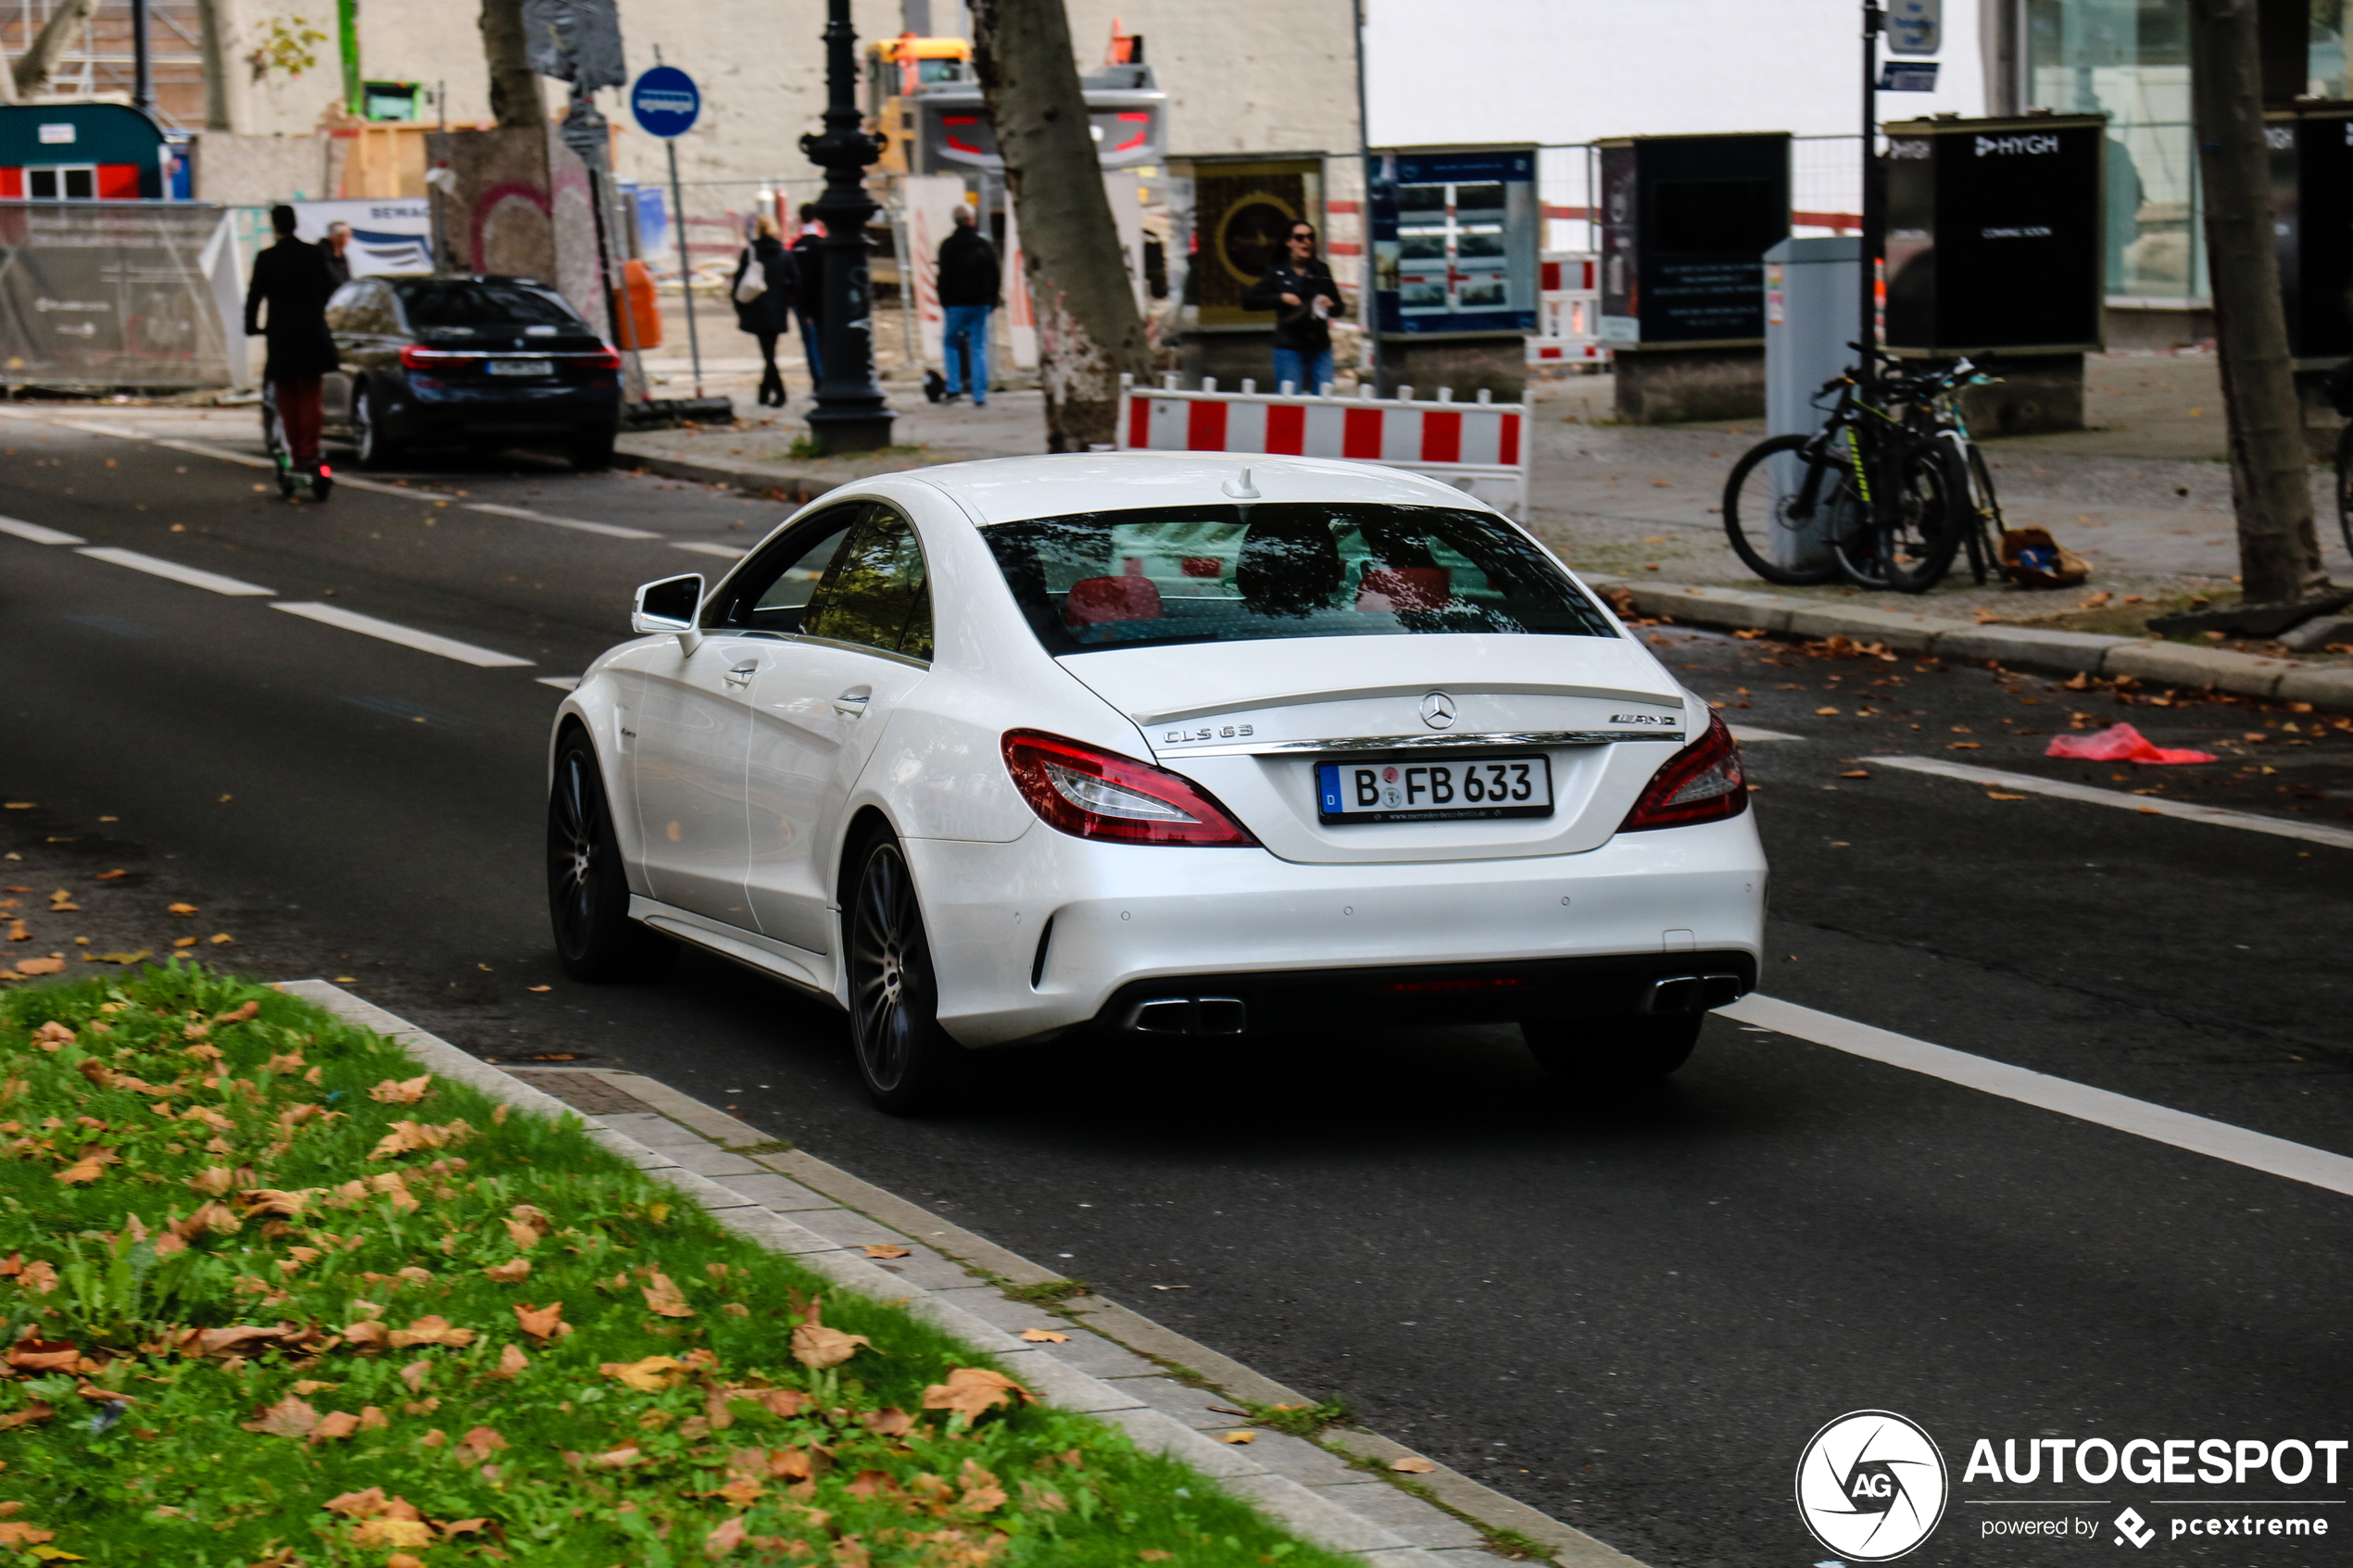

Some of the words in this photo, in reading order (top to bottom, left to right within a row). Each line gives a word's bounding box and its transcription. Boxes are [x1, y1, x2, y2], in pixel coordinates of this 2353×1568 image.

[1998, 135, 2058, 155] HYGH
[1631, 715, 1677, 726] AMG
[1164, 728, 1212, 743] CLS
[1219, 724, 1254, 738] 63
[1355, 770, 1379, 807] B
[1405, 767, 1453, 805] FB
[1464, 764, 1531, 803] 633
[1327, 794, 1336, 806] D
[1389, 810, 1487, 820] www.mercedes-benz-berlin.de
